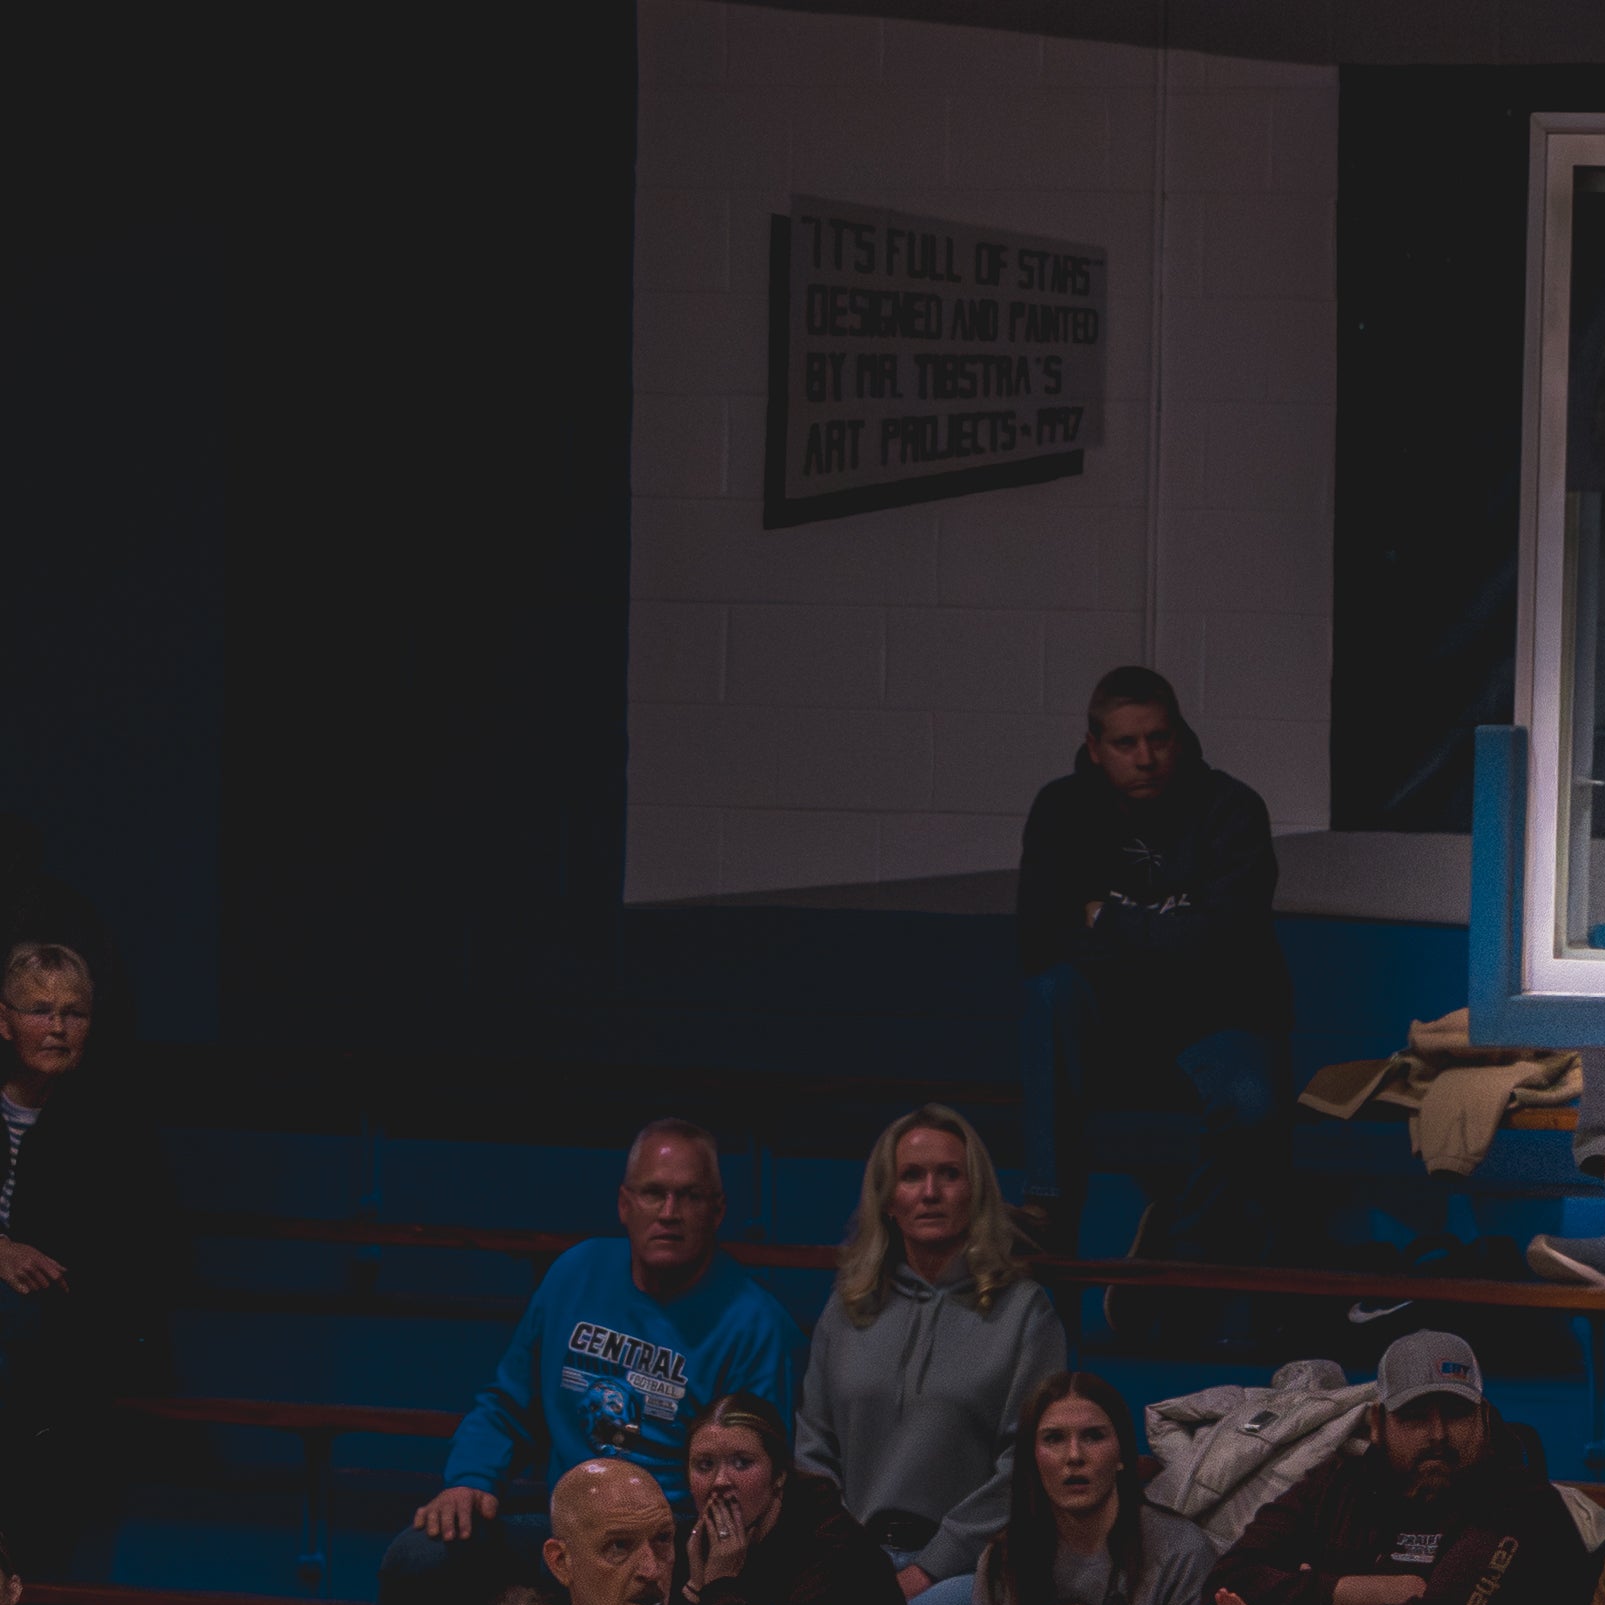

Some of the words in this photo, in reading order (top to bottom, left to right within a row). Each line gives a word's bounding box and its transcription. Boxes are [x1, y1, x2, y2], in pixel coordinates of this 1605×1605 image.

[887, 226, 964, 283] FULL
[975, 242, 1008, 286] OF
[807, 284, 942, 340] DESIGNED
[951, 298, 999, 342] AND
[1008, 302, 1099, 345] PAINTED
[806, 352, 846, 402] BY
[857, 354, 903, 399] MR.
[803, 419, 865, 476] ART
[569, 1321, 688, 1386] CENTRAL
[628, 1372, 680, 1398] FOOTBALL
